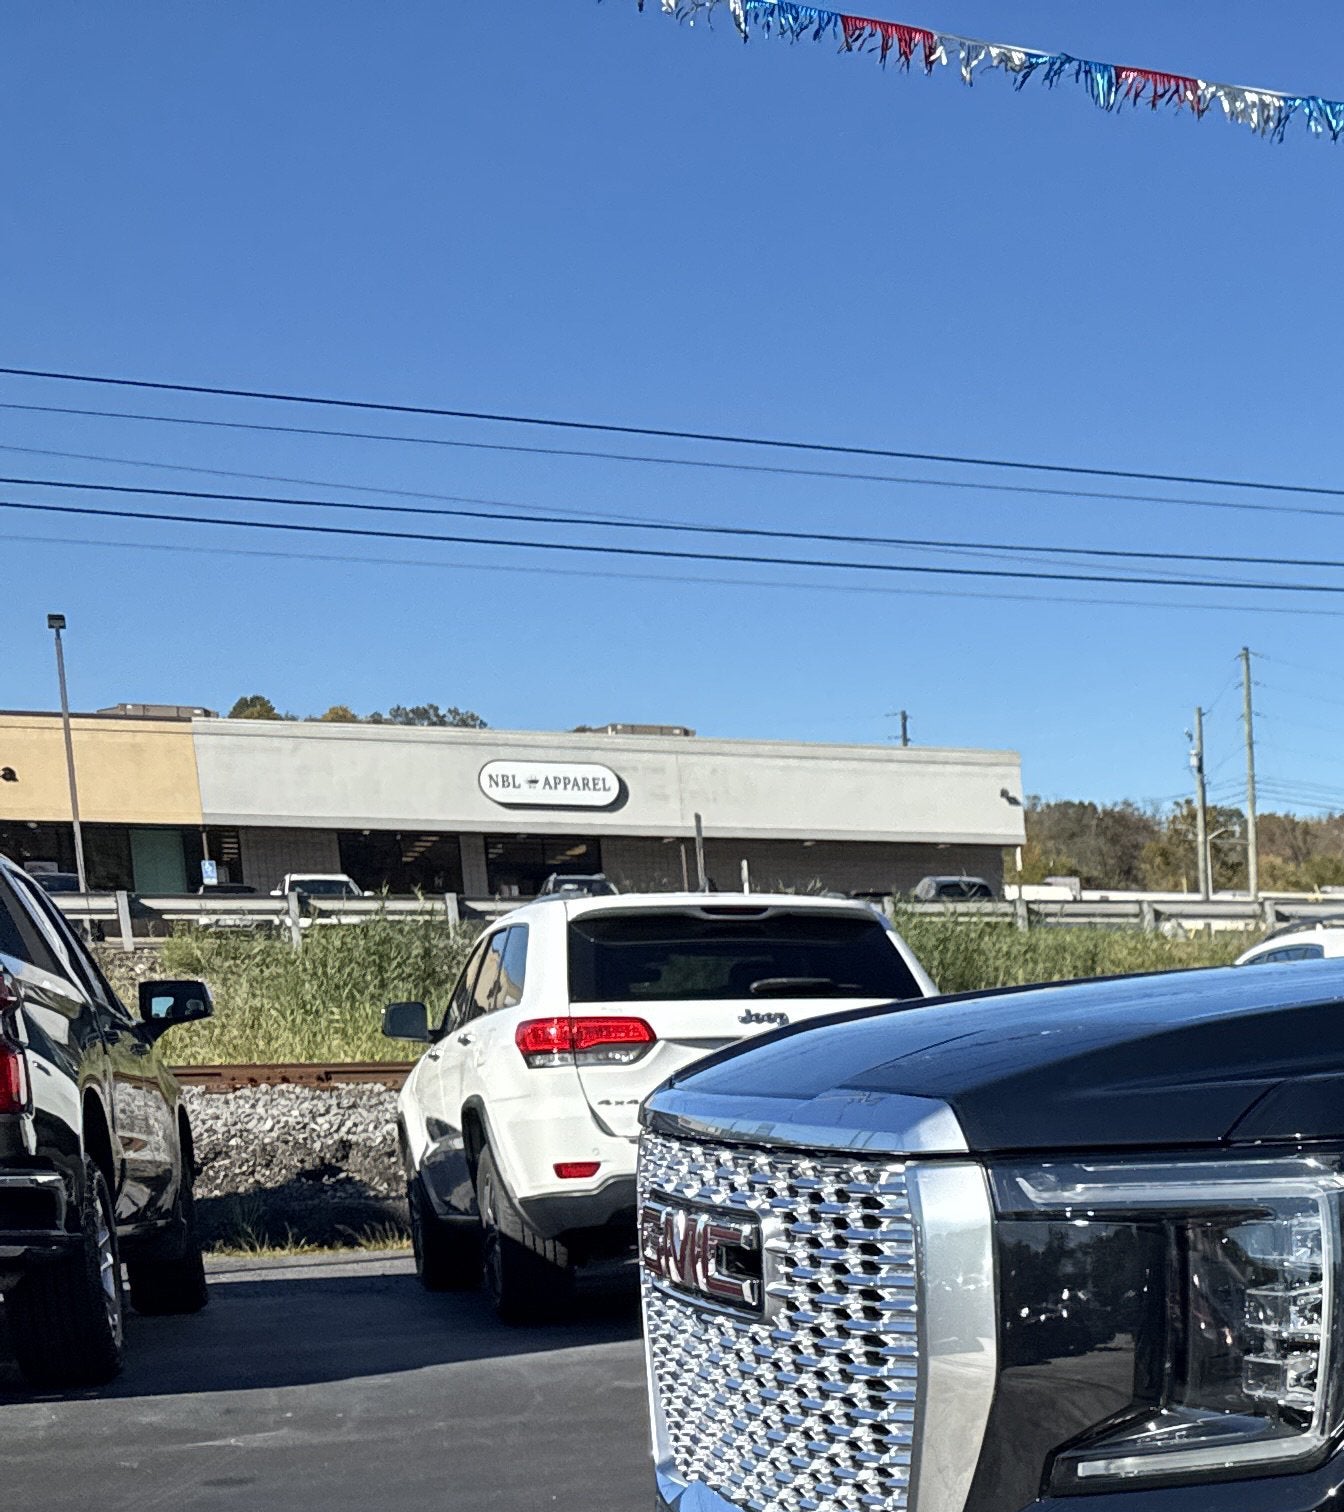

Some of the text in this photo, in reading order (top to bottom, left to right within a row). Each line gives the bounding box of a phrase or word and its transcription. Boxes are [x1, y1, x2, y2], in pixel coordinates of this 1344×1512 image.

[488, 774, 611, 792] NBL APPAREL
[738, 1008, 790, 1029] Jeep
